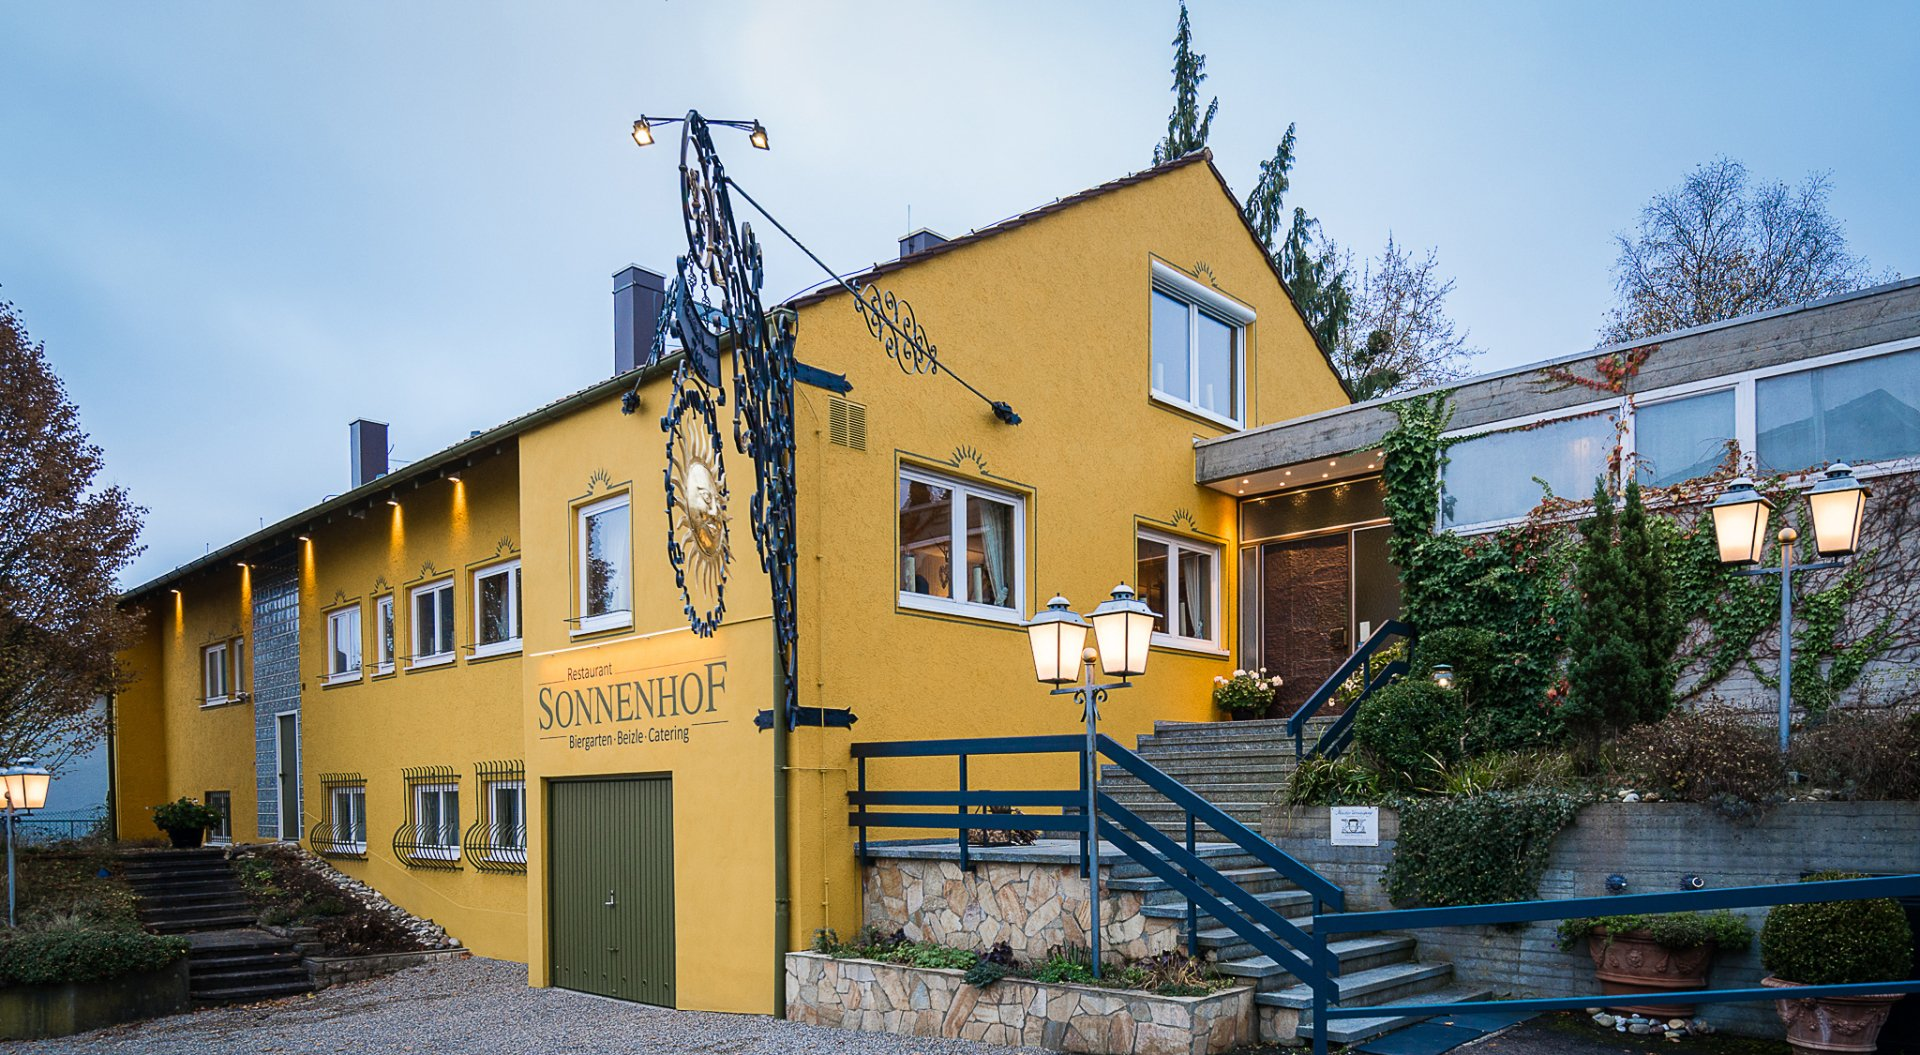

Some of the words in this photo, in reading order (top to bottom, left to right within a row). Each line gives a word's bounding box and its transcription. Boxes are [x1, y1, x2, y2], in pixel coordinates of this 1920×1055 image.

[567, 662, 612, 681] Restaurant
[538, 661, 727, 730] SONNENHOF
[569, 733, 612, 751] Biergarten
[617, 730, 643, 745] Beizle
[648, 725, 689, 743] Catering
